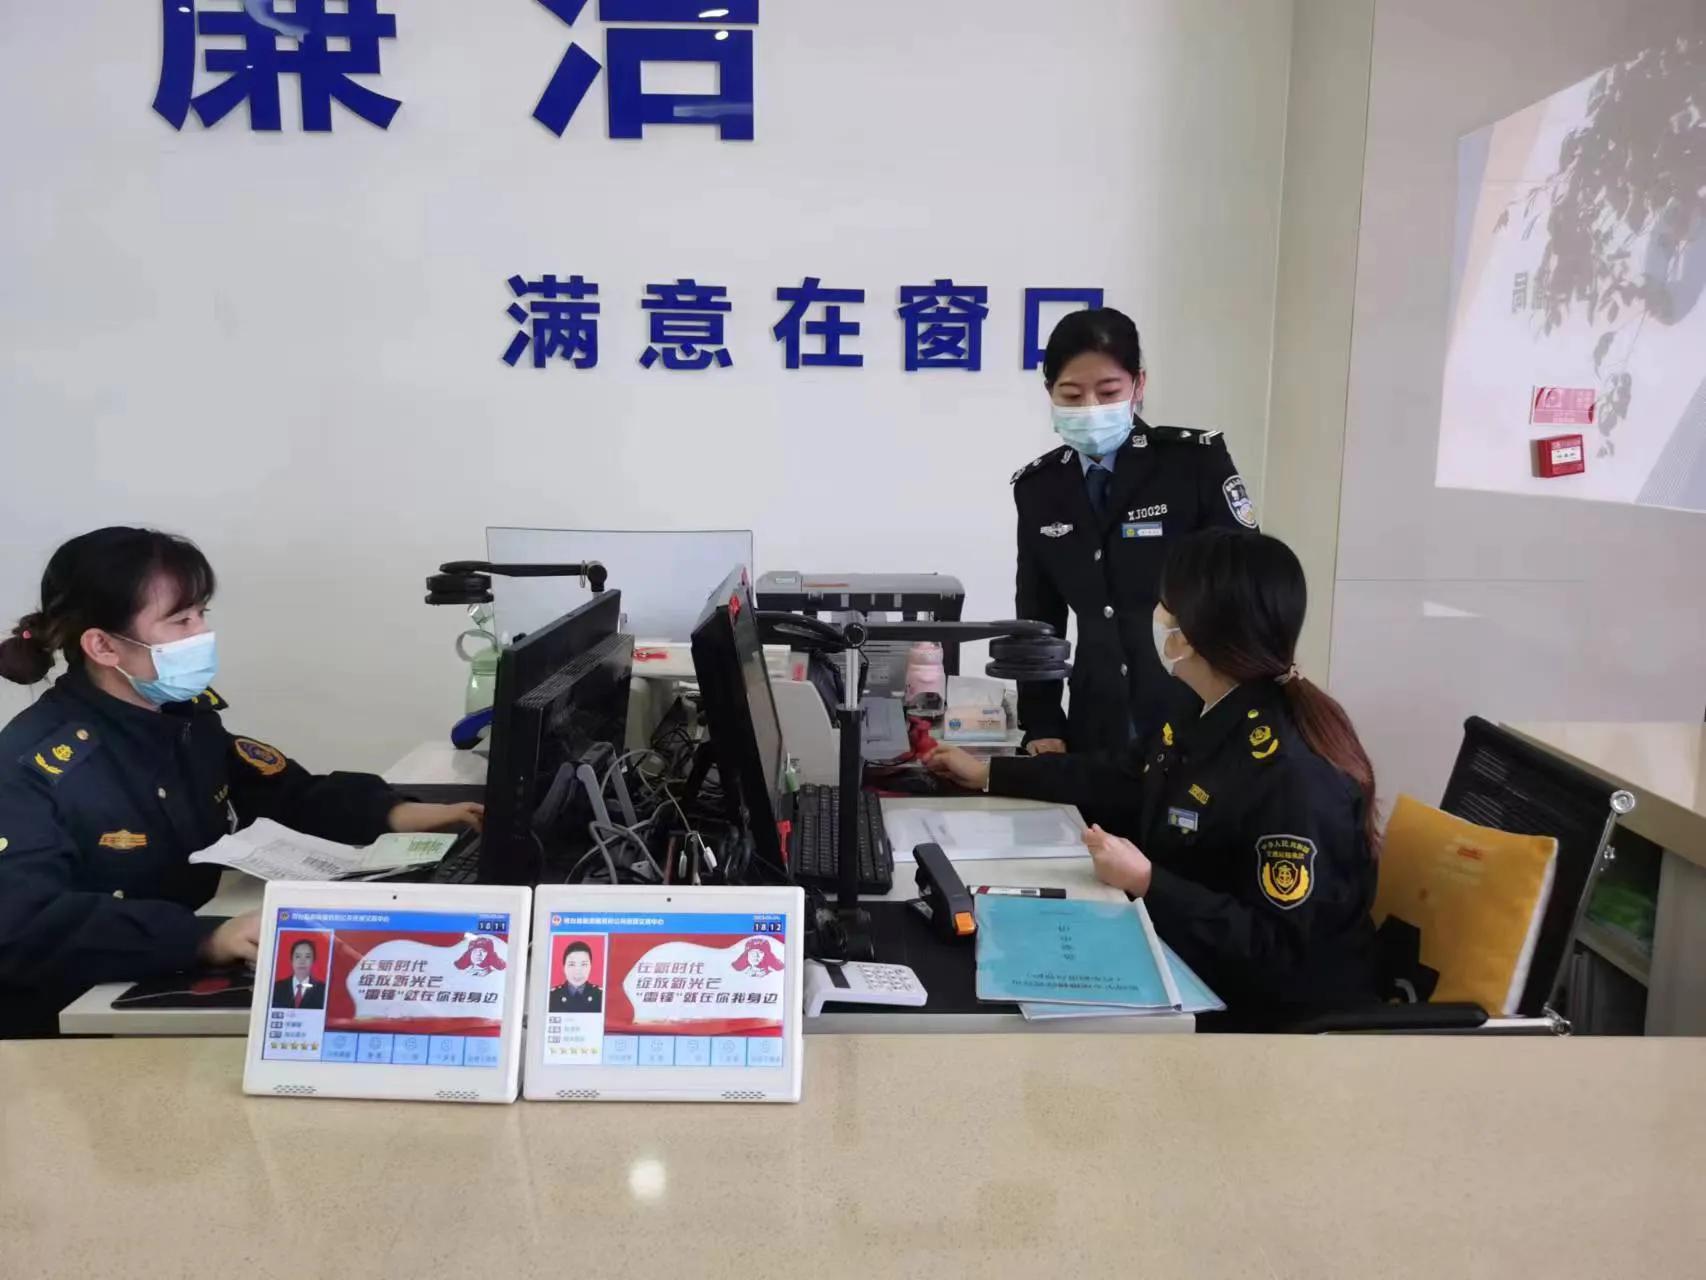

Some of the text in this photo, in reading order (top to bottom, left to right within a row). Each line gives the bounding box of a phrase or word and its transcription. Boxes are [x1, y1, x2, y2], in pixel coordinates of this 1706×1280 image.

[1128, 503, 1169, 521] XJ0028
[637, 962, 705, 974] 在新时代
